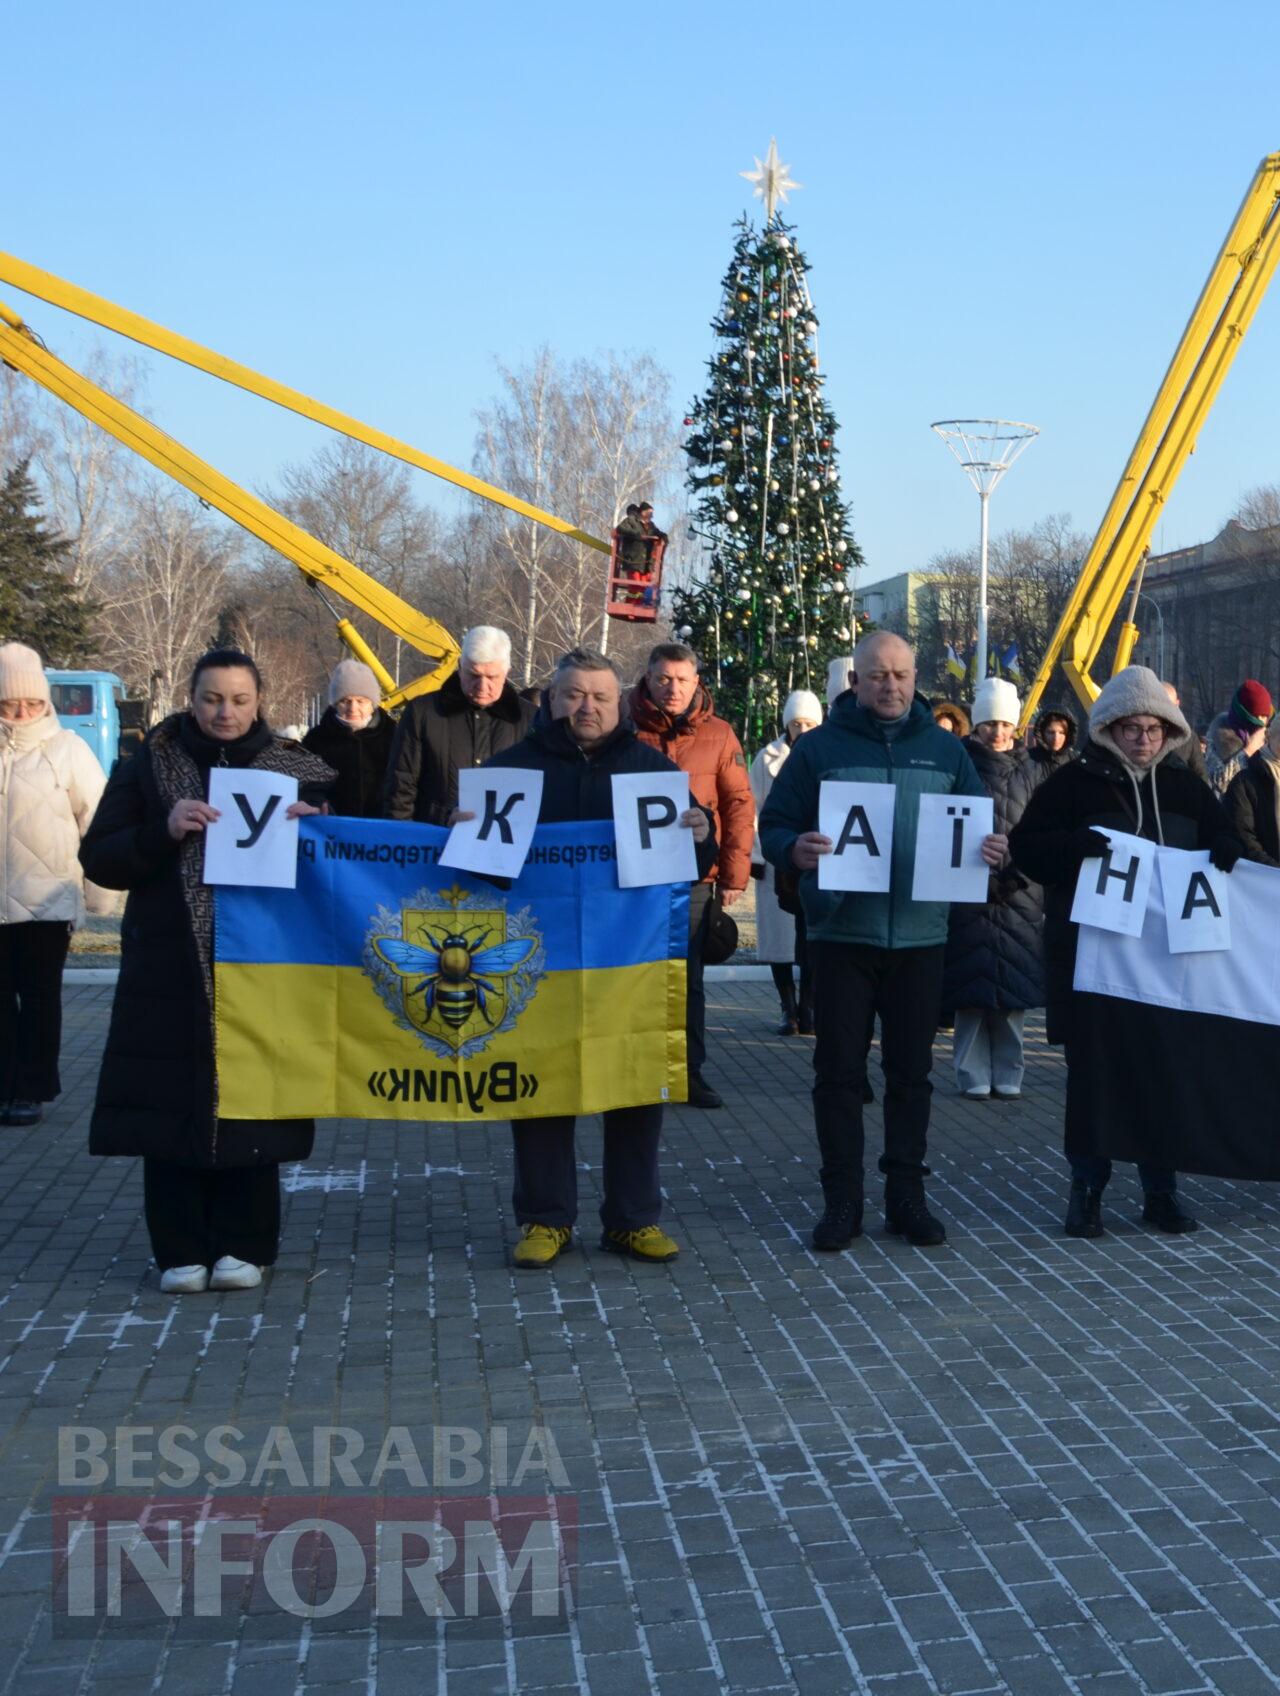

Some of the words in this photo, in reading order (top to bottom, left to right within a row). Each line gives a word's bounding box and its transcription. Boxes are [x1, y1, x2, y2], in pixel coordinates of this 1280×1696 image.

[231, 792, 282, 848] У
[477, 789, 525, 845] К
[636, 795, 677, 849] Р
[833, 805, 880, 857] А
[947, 807, 970, 868] Ї
[1096, 849, 1140, 903] Н
[1181, 871, 1221, 920] А
